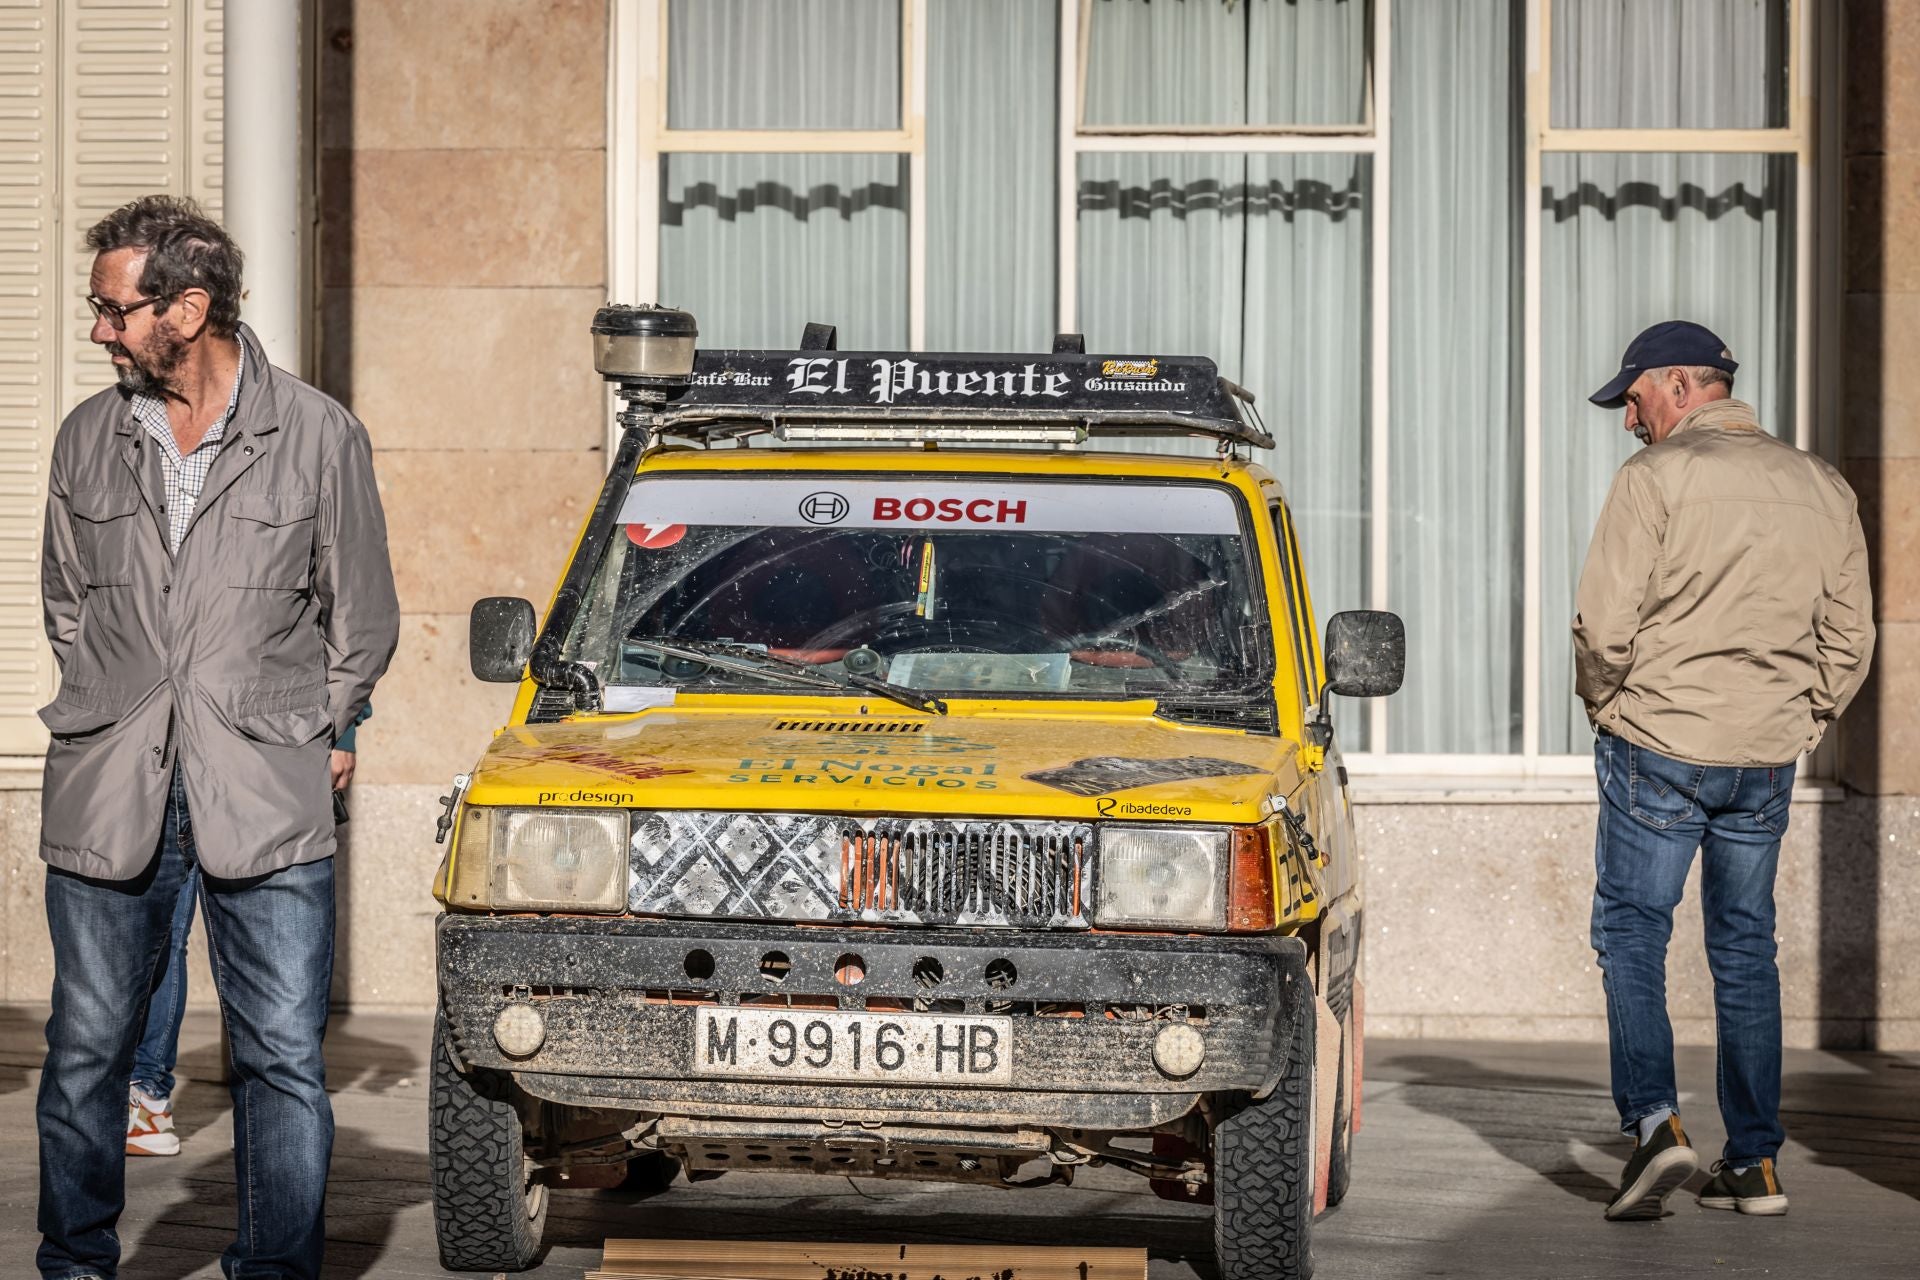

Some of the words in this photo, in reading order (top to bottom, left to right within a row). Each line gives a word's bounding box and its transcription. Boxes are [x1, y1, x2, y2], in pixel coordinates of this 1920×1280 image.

[733, 371, 773, 386] Bar
[786, 358, 852, 394] El
[869, 358, 1071, 403] Puente
[1084, 377, 1186, 392] Guisando
[873, 497, 1027, 524] BOSCH
[735, 758, 796, 770] El
[816, 759, 998, 777] Nogal
[727, 774, 998, 789] SERVICIOS
[538, 789, 634, 806] prodesign
[1120, 802, 1192, 816] ribadedeva
